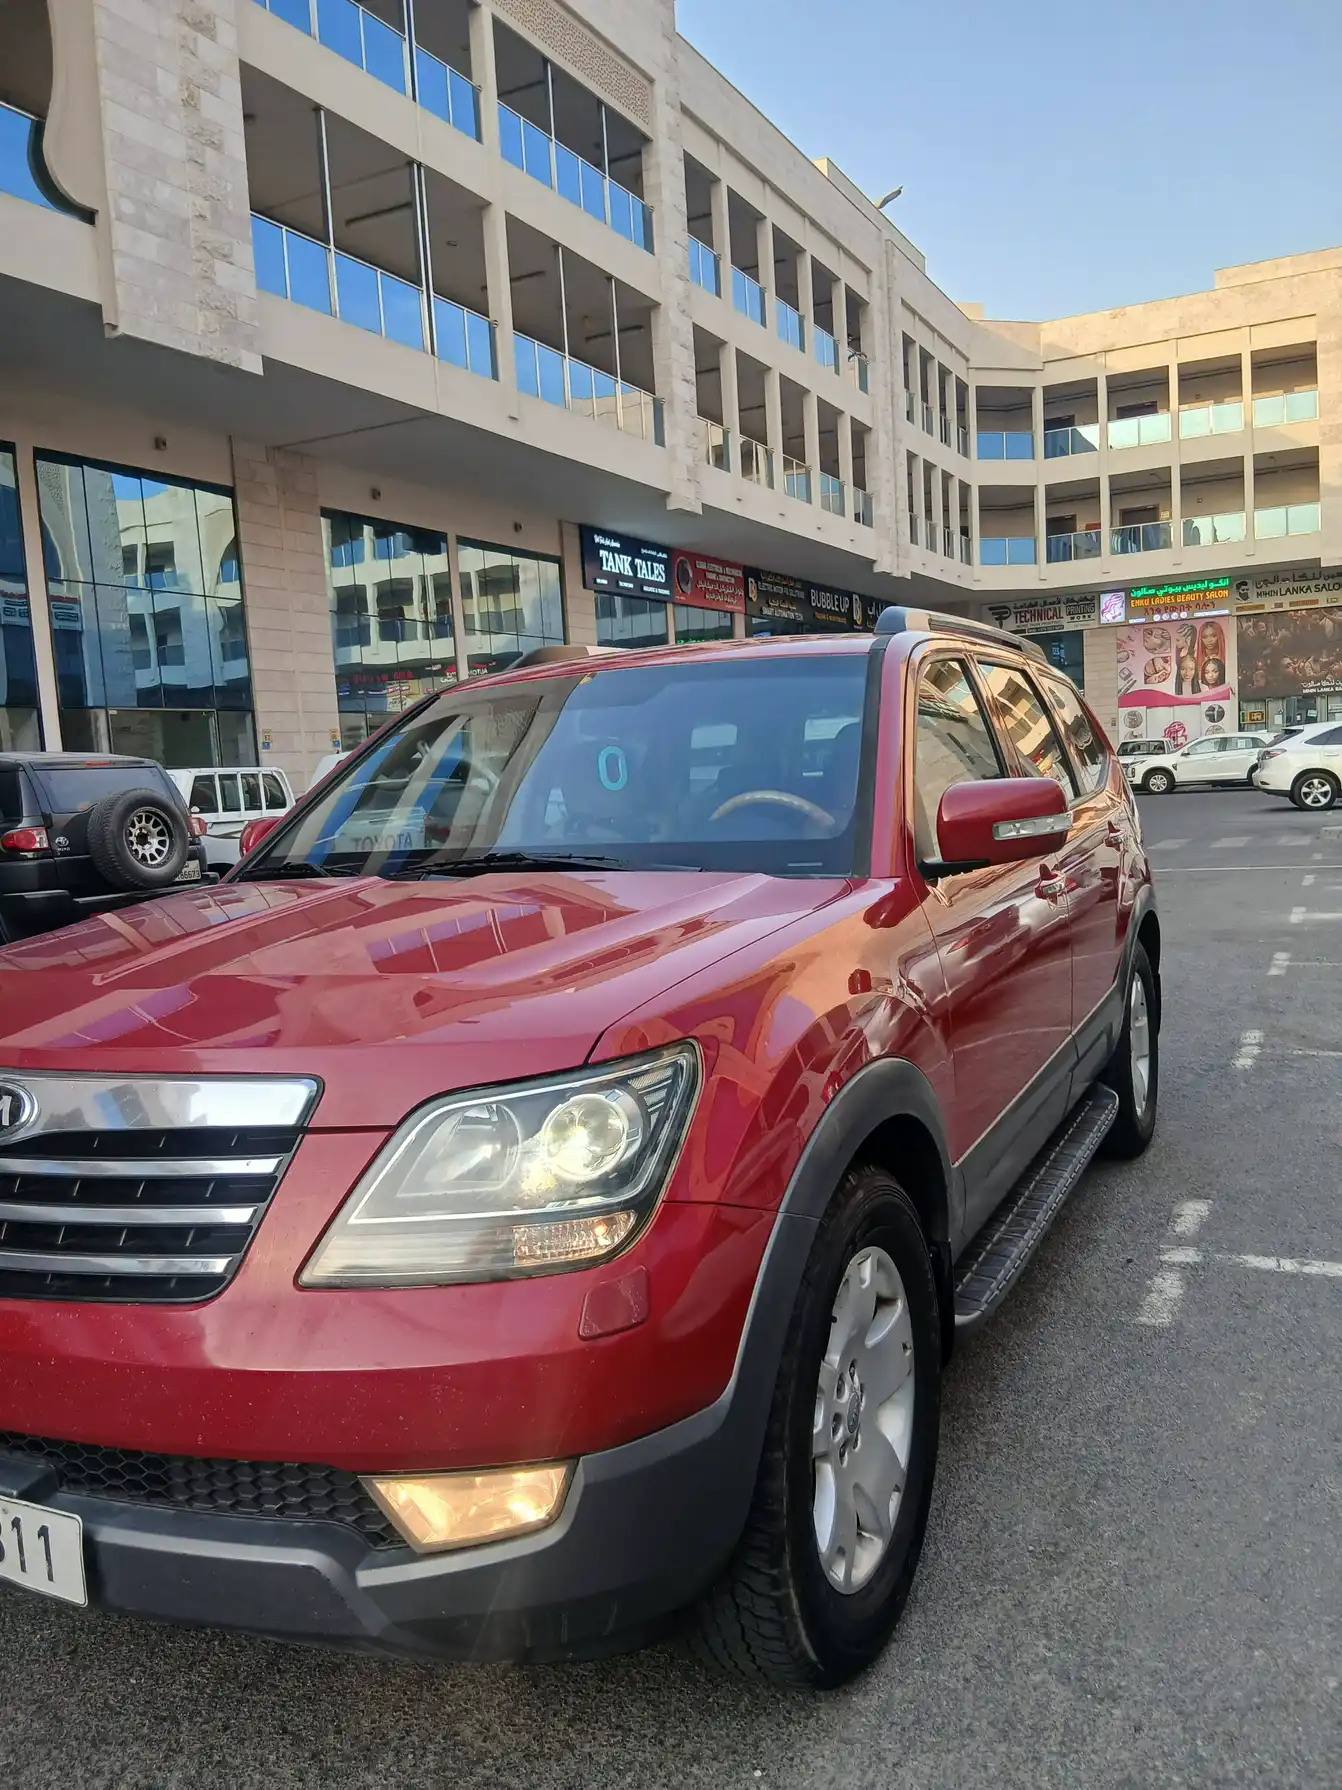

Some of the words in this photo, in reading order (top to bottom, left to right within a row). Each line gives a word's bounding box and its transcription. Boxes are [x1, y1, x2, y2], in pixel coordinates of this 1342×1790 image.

[599, 549, 633, 576] TANK
[634, 558, 666, 583] TALES
[1279, 585, 1312, 596] LANKA
[1314, 582, 1342, 593] SALO
[810, 589, 839, 612] BUBBLE
[840, 596, 850, 613] UP
[1130, 598, 1151, 609] ENKU
[1151, 596, 1175, 605] LADIES
[1176, 592, 1204, 602] BEAUTY
[1205, 590, 1229, 599] SALON
[1013, 605, 1064, 624] TECHNICAL
[1066, 603, 1095, 616] PRINTING
[0, 1516, 54, 1583] 11
